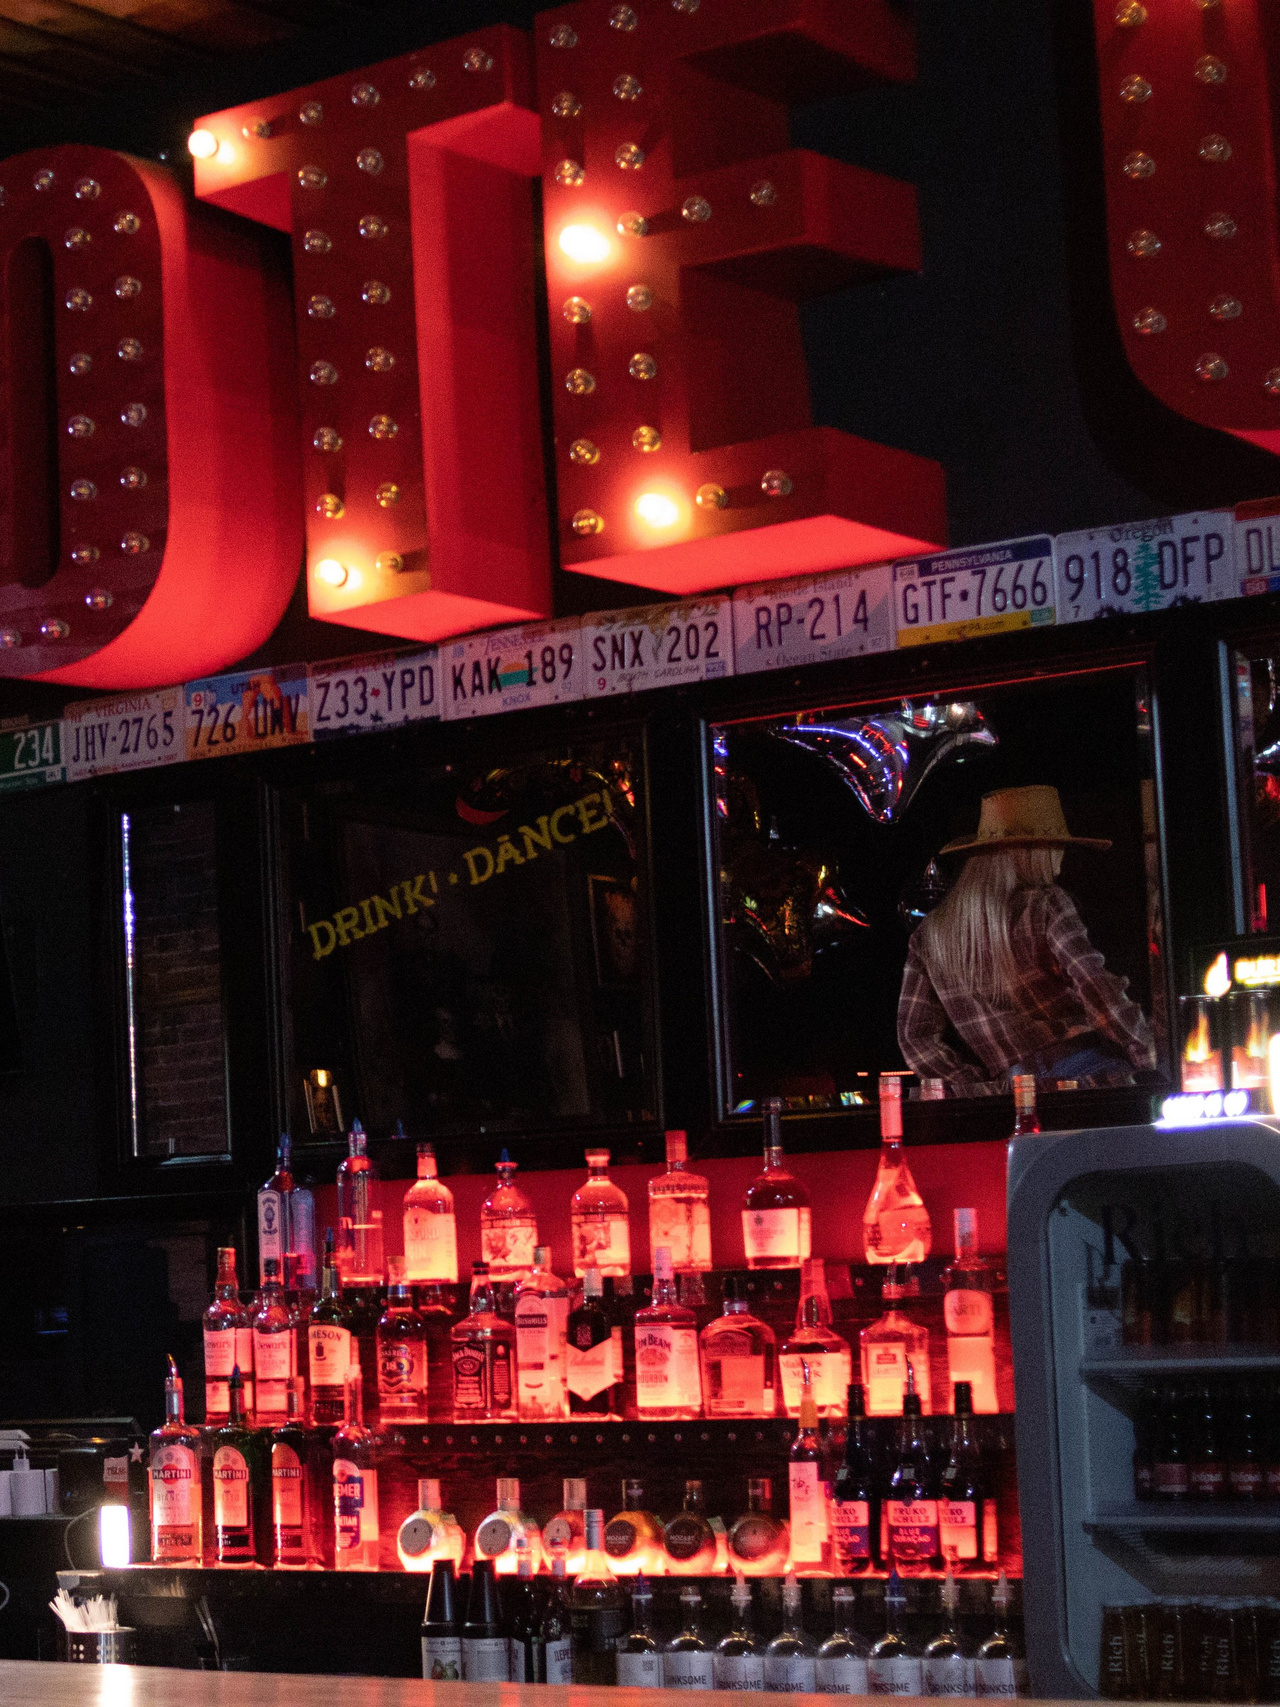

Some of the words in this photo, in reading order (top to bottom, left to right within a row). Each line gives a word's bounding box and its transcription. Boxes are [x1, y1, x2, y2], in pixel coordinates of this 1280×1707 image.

[1110, 519, 1174, 542] Oregon
[931, 549, 1013, 572] PENNSYLVANIA
[1065, 548, 1131, 602] 918
[1157, 533, 1225, 590] DFP
[812, 573, 852, 592] Island
[755, 589, 869, 649] RP-214
[592, 630, 644, 672] SNX
[667, 621, 719, 663] 202
[776, 648, 817, 666] Ocean
[820, 645, 853, 660] State
[452, 655, 502, 700] KAK
[524, 643, 573, 687] 189
[231, 680, 261, 695] UTAH
[315, 676, 368, 722] Z33
[382, 664, 434, 711] YPD
[502, 692, 531, 706] KNOX
[94, 697, 151, 718] VIRGINIA
[191, 705, 237, 747] 726
[13, 725, 54, 771] 234
[463, 790, 613, 887] DANCE!
[153, 1469, 191, 1480] MARTINI
[214, 1469, 247, 1480] MARTINI
